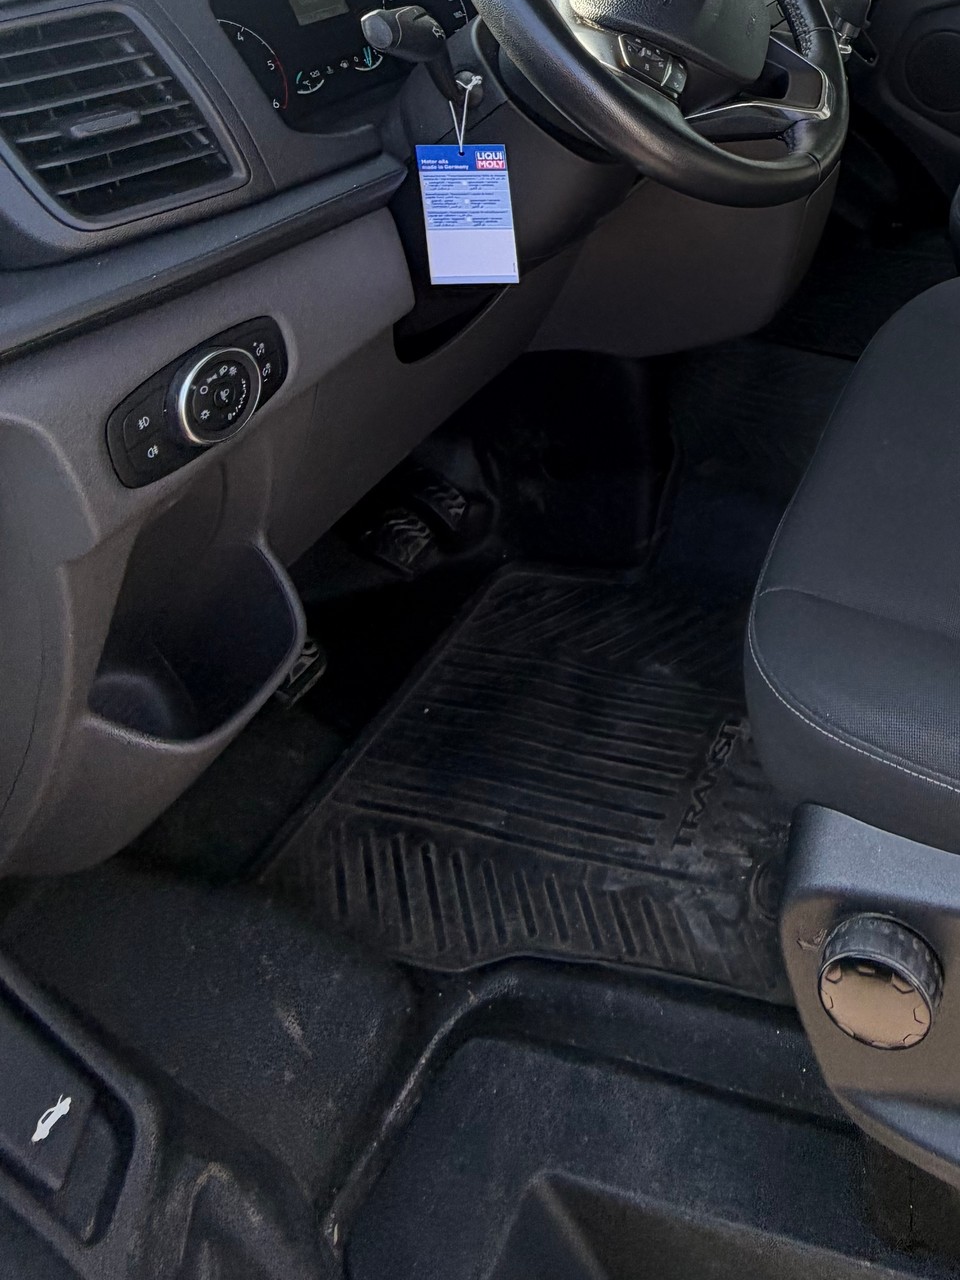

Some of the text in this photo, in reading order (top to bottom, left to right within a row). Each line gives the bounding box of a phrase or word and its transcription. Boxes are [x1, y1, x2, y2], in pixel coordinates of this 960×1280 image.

[237, 31, 244, 41] 4
[267, 60, 275, 70] 5
[273, 98, 280, 108] 6
[477, 152, 503, 160] LIQUI
[477, 160, 504, 169] MOLY
